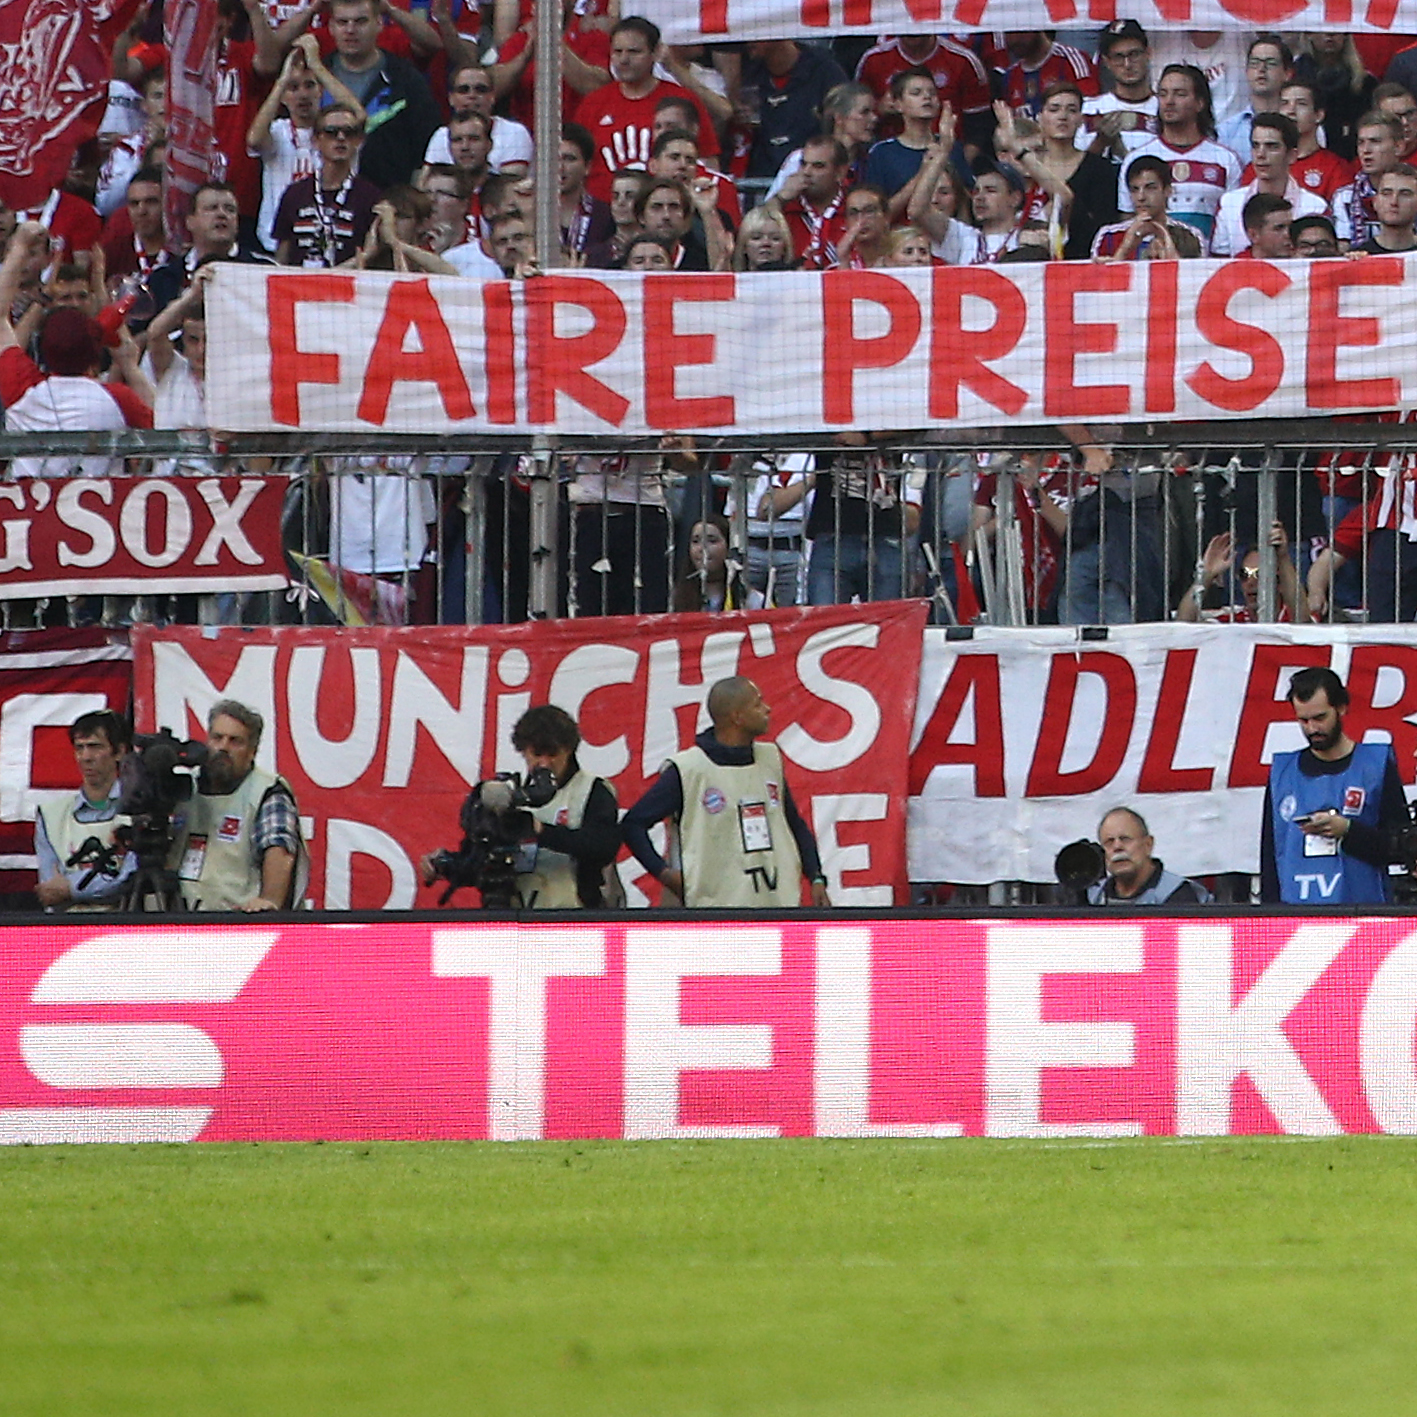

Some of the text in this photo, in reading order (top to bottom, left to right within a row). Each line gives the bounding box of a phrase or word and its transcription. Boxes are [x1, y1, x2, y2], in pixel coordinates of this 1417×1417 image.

[267, 274, 735, 430] FAIRE
[822, 258, 1405, 423] PREISE
[744, 867, 778, 894] TV
[1294, 873, 1342, 900] TV
